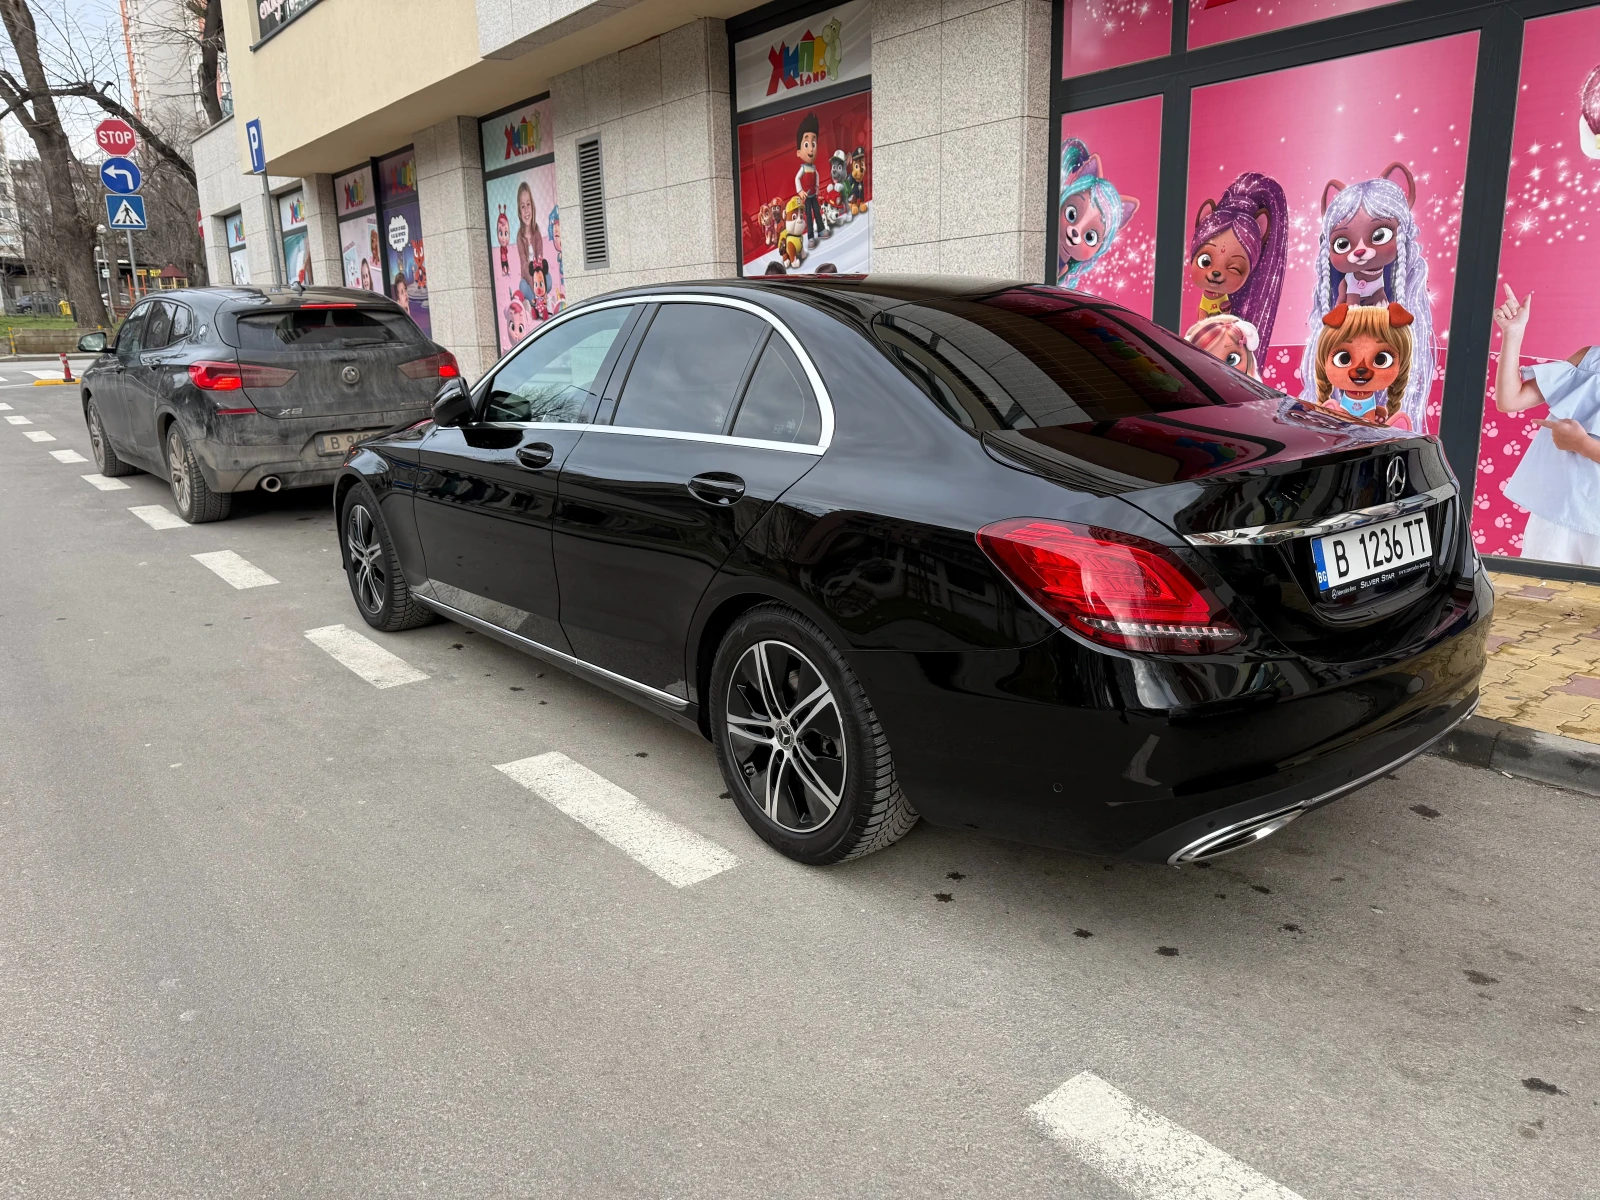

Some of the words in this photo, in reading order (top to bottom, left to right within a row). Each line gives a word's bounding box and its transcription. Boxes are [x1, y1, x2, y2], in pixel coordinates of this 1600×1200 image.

[800, 70, 826, 87] LAND
[99, 130, 132, 144] STOP
[249, 126, 259, 167] P
[330, 436, 340, 450] B
[1333, 540, 1350, 579] B
[1359, 524, 1404, 570] 1236
[1403, 517, 1425, 556] TT
[1318, 570, 1327, 584] BG
[1360, 577, 1380, 589] SILVER
[1381, 572, 1395, 582] STAR
